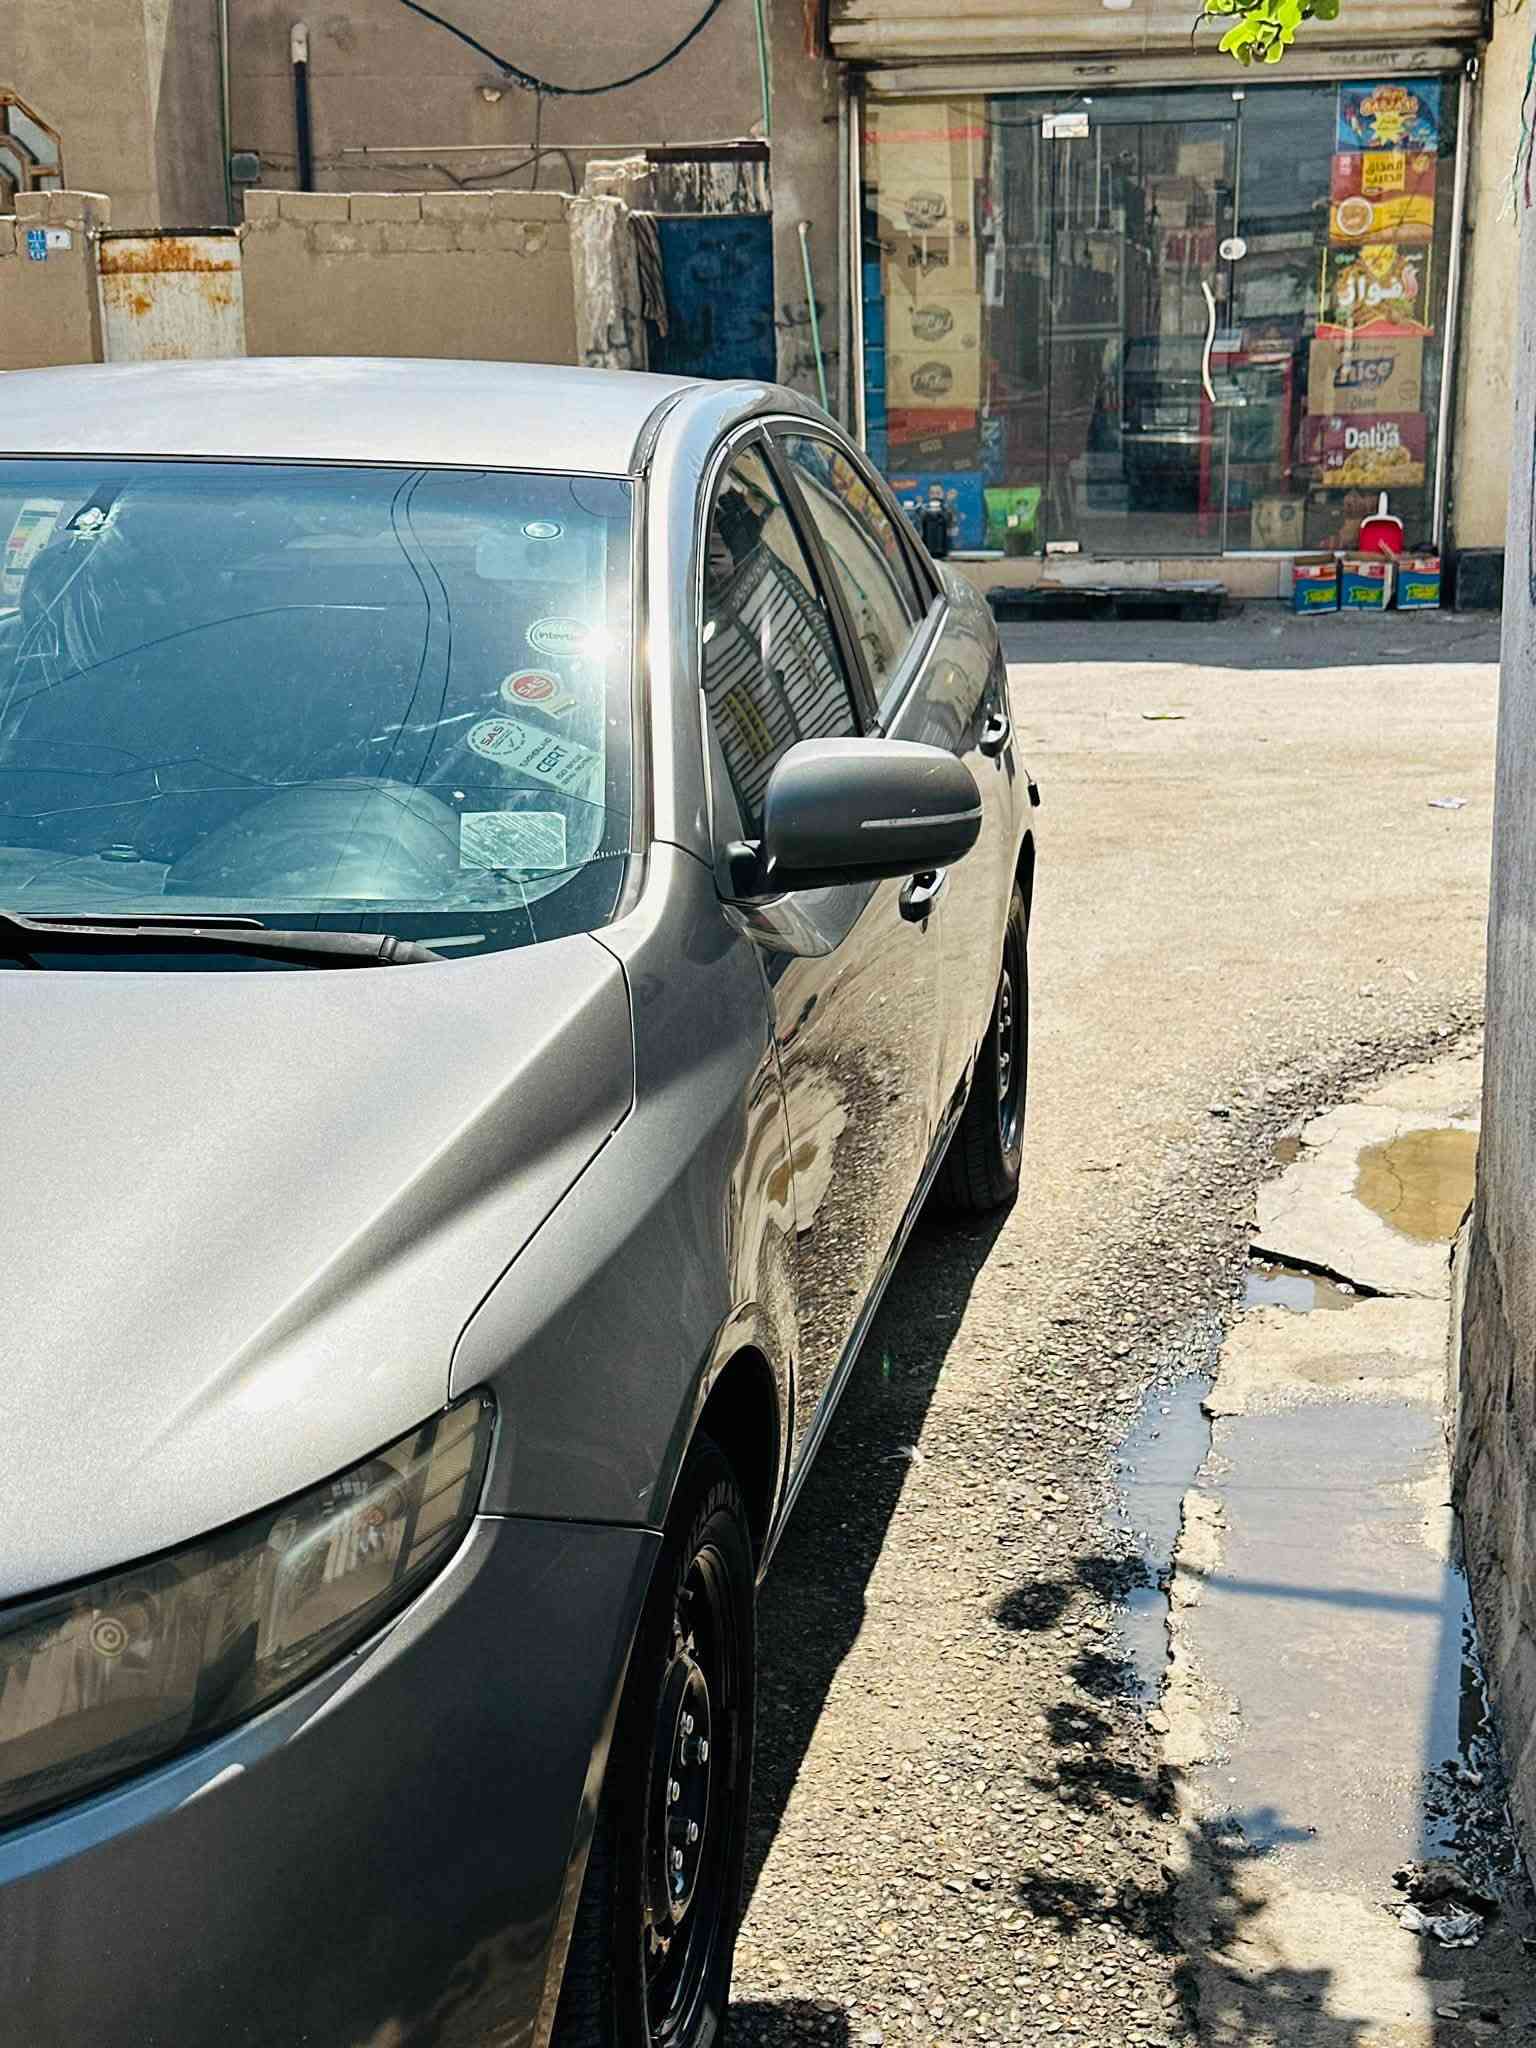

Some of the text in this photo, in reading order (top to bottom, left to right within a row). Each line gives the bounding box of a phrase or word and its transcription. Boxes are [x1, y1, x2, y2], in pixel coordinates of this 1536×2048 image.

[1344, 426, 1400, 455] Dalya
[480, 725, 505, 746] SAS
[535, 744, 569, 774] CERT
